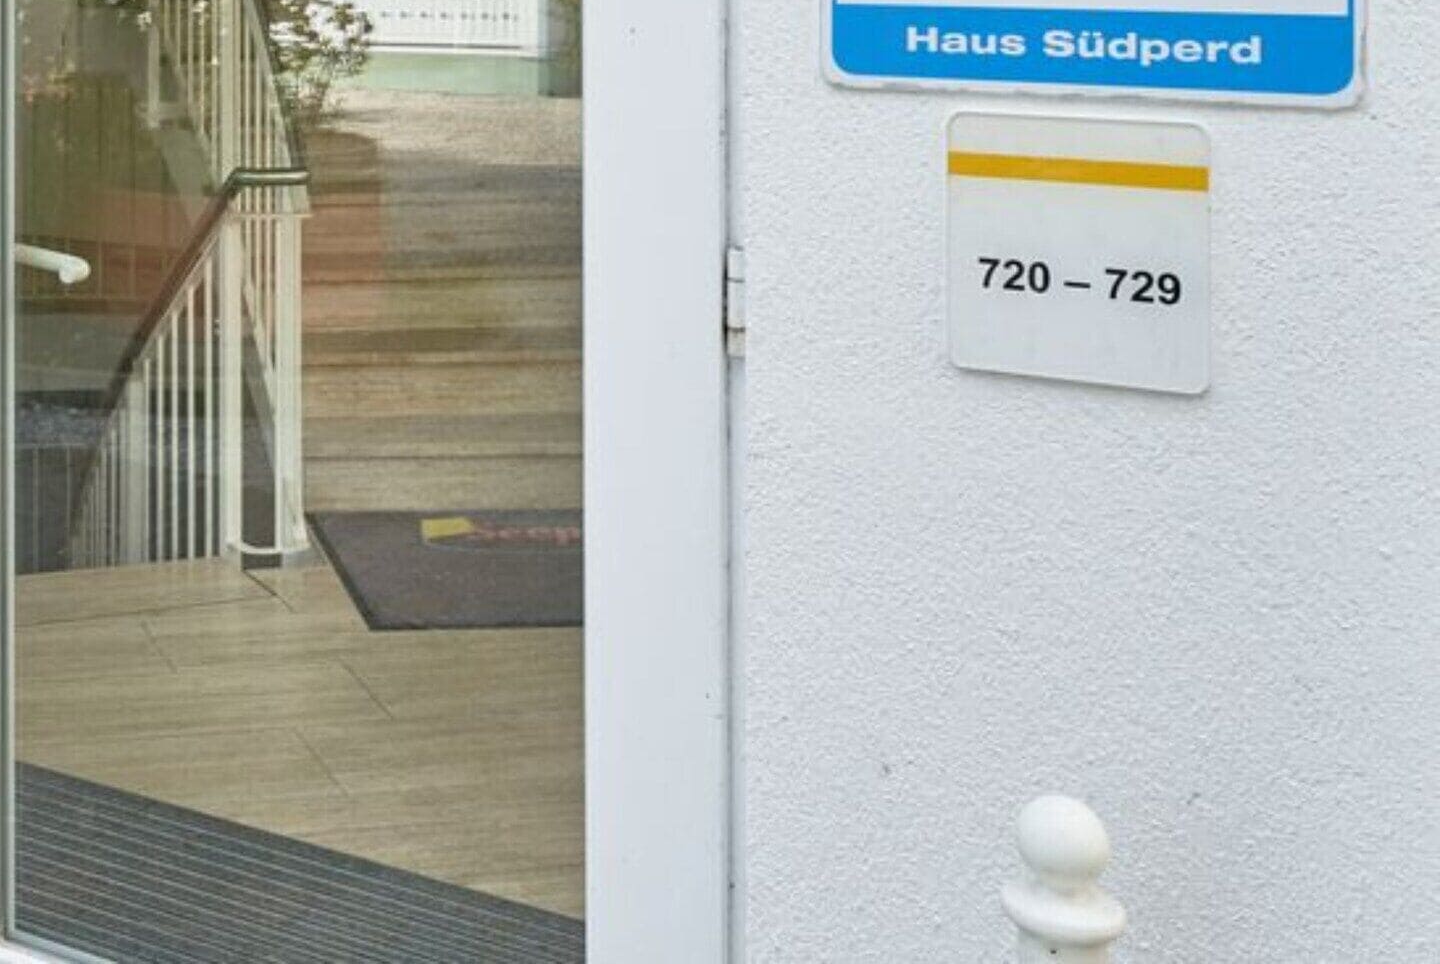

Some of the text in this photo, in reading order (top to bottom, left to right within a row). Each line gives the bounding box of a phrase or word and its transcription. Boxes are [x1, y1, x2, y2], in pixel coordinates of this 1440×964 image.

[905, 26, 1262, 67] Haus Südperd
[977, 258, 1050, 293] 720
[1104, 269, 1182, 305] 729
